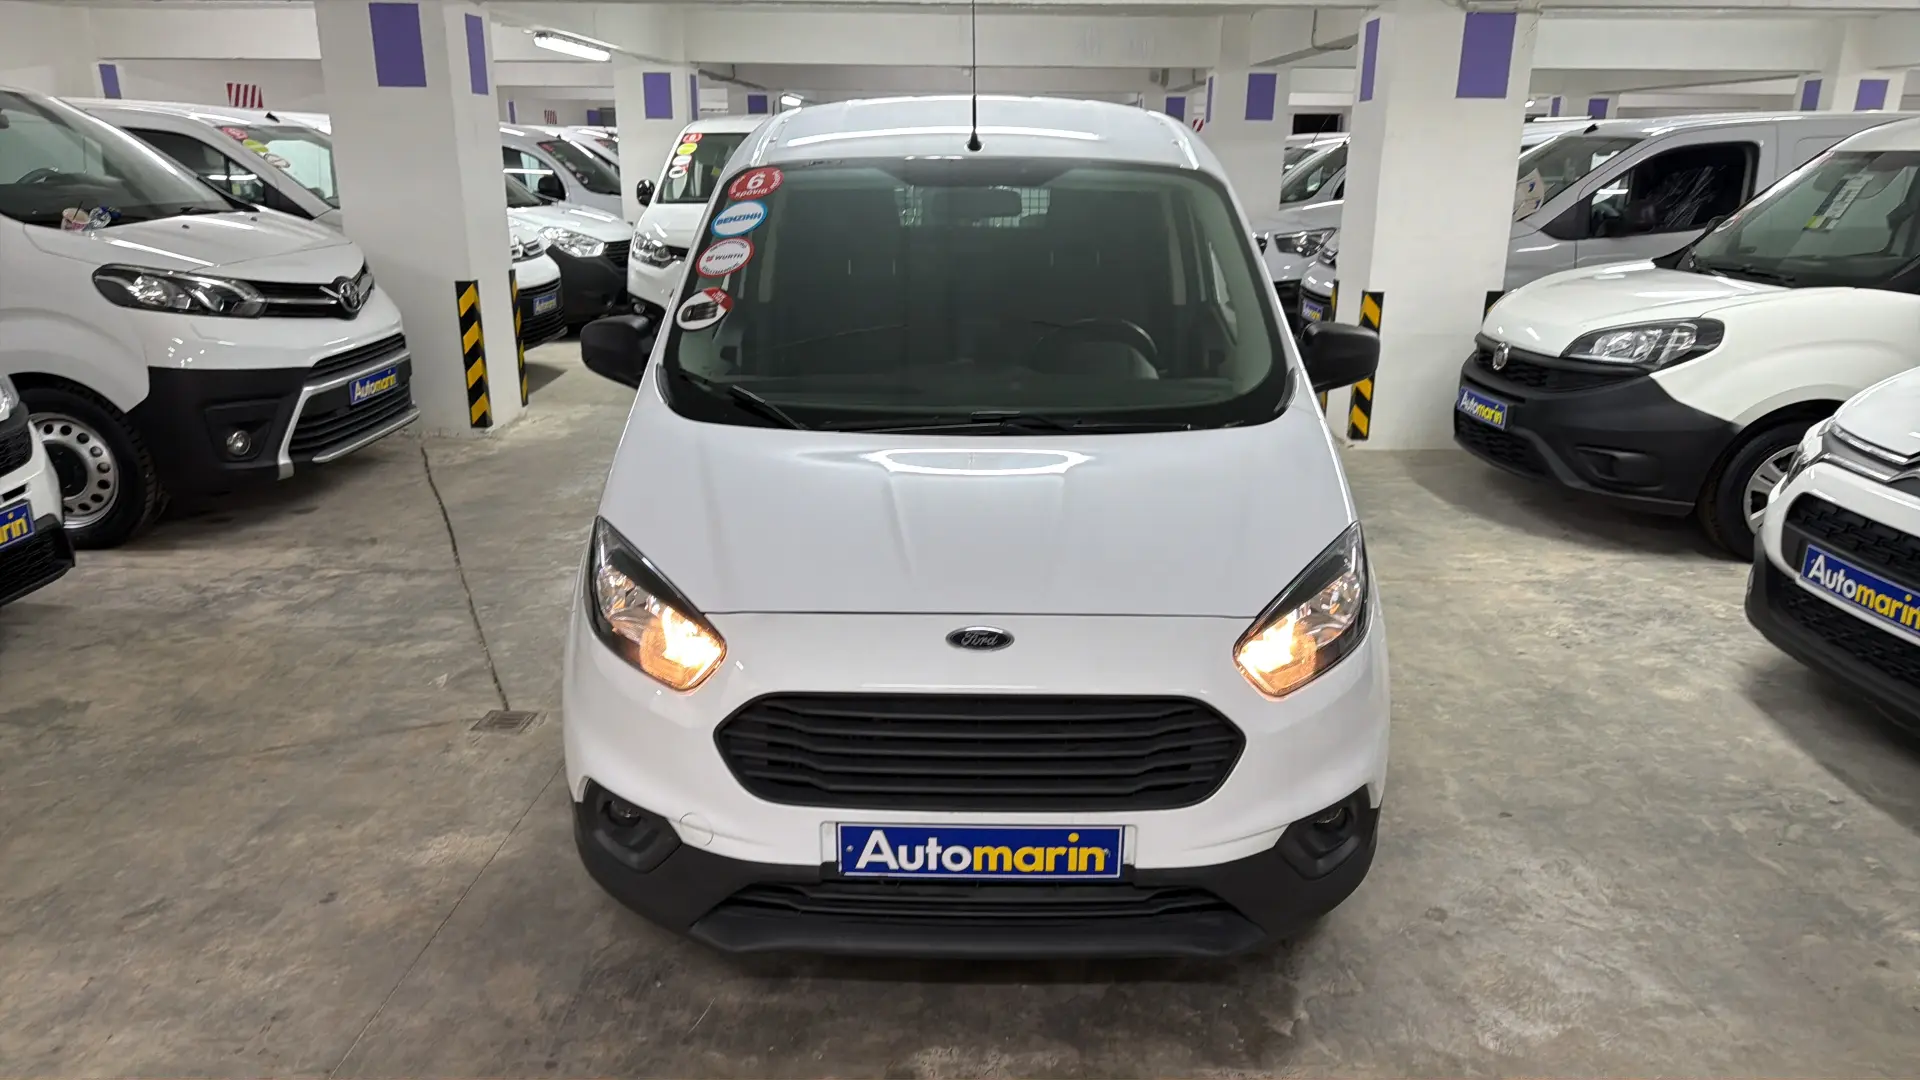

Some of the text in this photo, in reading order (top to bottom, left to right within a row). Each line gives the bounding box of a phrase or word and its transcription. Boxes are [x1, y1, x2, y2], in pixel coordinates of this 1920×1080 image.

[746, 172, 766, 190] 6
[354, 368, 396, 401] Automarin
[1460, 390, 1503, 425] Automarin
[1808, 554, 1920, 630] Automarin
[960, 631, 998, 646] Ford
[855, 829, 1105, 872] Automarin
